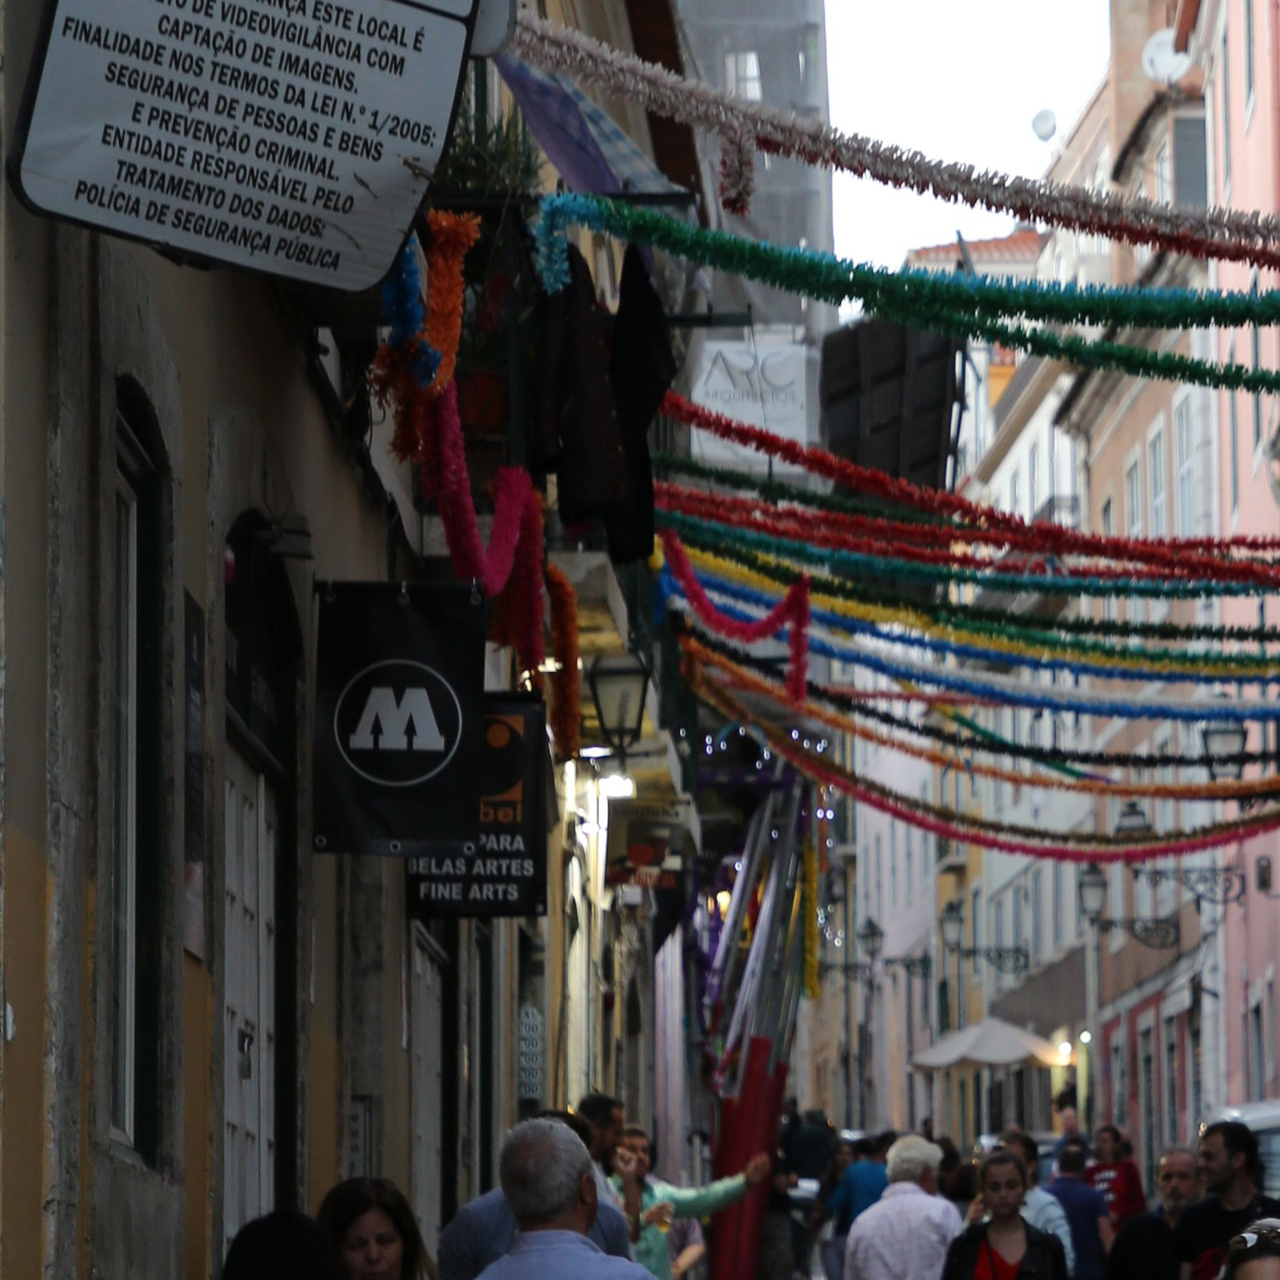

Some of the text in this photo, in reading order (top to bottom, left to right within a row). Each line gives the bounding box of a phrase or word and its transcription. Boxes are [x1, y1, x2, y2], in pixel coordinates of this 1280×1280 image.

[158, 14, 358, 94] CAPTAÇÃO DE IMAGENS.
[221, 1, 361, 64] VIDEOVIGILÂNCIA
[367, 47, 405, 76] COM
[312, 0, 354, 30] ESTE
[357, 13, 407, 48] LOCAL
[412, 26, 425, 52] É
[62, 15, 166, 66] FINALIDADE
[169, 49, 205, 77] NOS
[210, 60, 280, 100] TERMOS
[283, 84, 305, 109] DA
[311, 91, 338, 118] LEI
[368, 109, 436, 147] 1/2005:
[104, 62, 384, 162] SEGURANÇA DE PESSOAS E BENS
[101, 124, 354, 214] ENTIDADE RESPONSÁVEL PELO
[131, 101, 339, 182] E PREVENÇÃO CRIMINAL.
[74, 180, 341, 271] POLÍCIA DE SEGURANÇA PÚBLICA
[116, 159, 326, 238] TRATAMENTO DOS DADOS:
[349, 686, 445, 751] M
[479, 799, 523, 824] bel
[407, 857, 534, 877] BELAS ARTES
[419, 882, 519, 901] FINE ARTS
